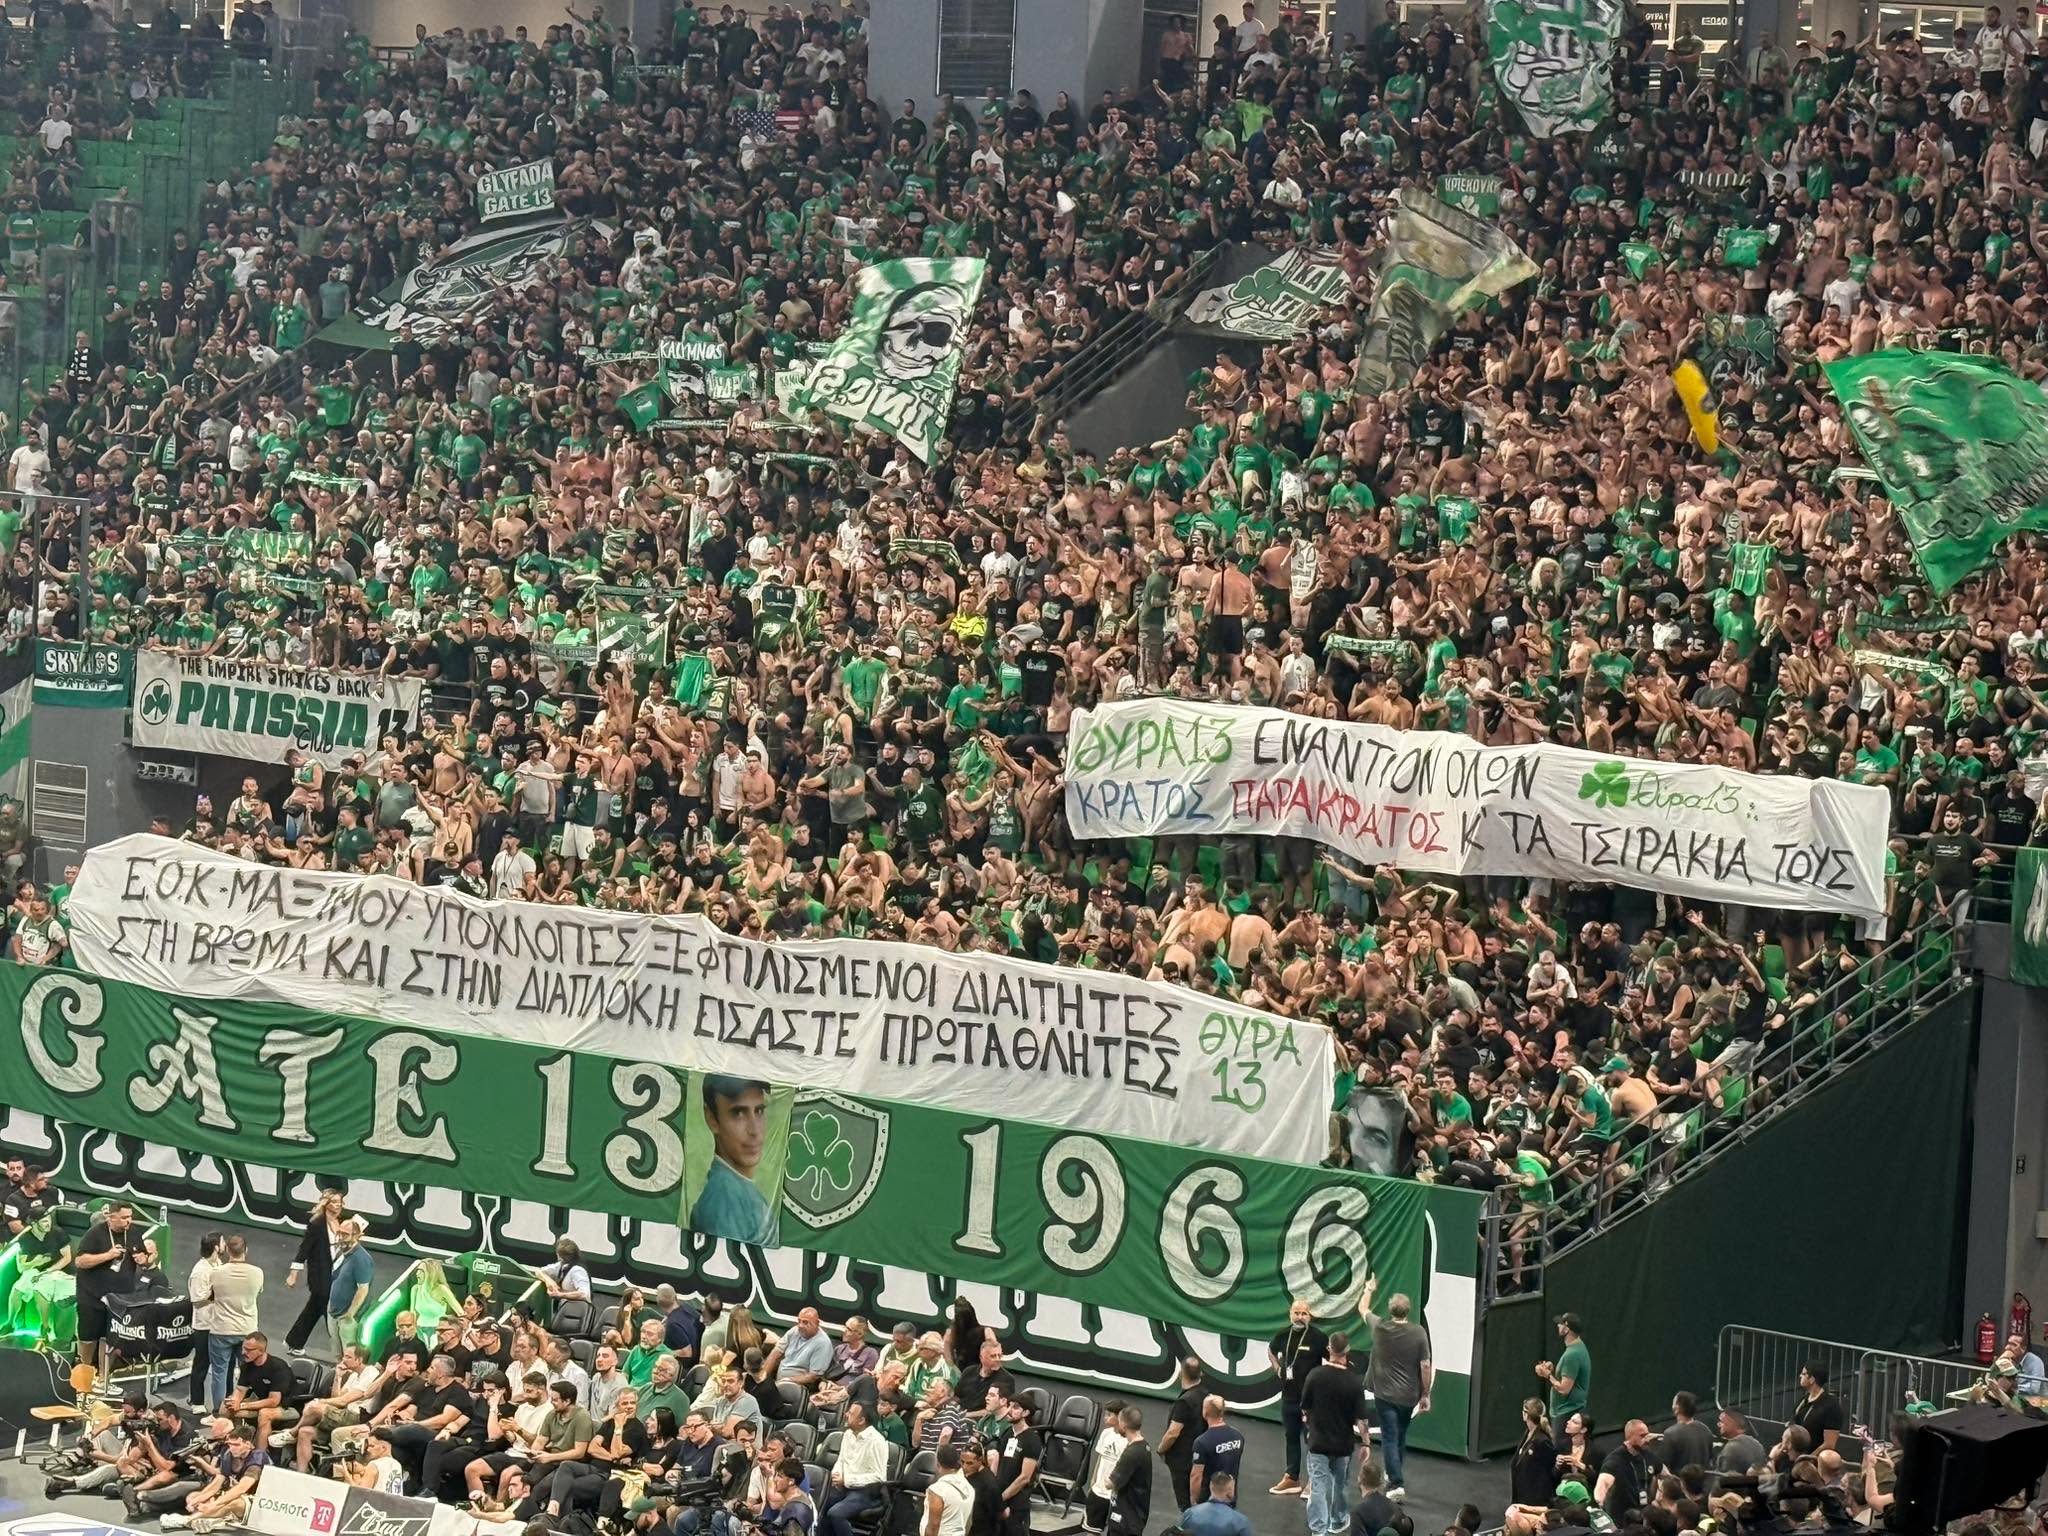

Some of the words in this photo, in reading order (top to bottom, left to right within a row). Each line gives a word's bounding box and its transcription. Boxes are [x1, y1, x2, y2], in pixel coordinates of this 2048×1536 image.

[477, 161, 555, 194] GLYFADA
[484, 193, 531, 215] GATE
[532, 187, 553, 206] 13
[179, 657, 202, 676] THE
[207, 660, 262, 684] EMPIRE
[267, 667, 331, 694] STRIKES
[337, 678, 370, 699] BACK
[175, 680, 369, 748] PATISSIA
[296, 727, 334, 754] Club
[1252, 717, 1441, 797] ΕΝΑΝΤΙΟΝ
[1445, 749, 1541, 801] ΟΛΩΝ
[1074, 778, 1215, 825] ΚΡΑΤΟΣ
[1229, 775, 1449, 853] ΠΑΡΑΚΡΑΤΟΣ
[1499, 811, 1556, 860] ΤΑ
[1570, 821, 1753, 887] ΤΣΙΡΑΚΙΑ
[1772, 841, 1856, 892] ΤΟΥΣ
[108, 915, 179, 964] ΣΤΗ
[187, 922, 309, 972] ΒΡΩΜΑ
[322, 936, 390, 988] ΚΑΙ
[401, 948, 502, 1007] ΣΤΗΝ
[515, 965, 680, 1031] ΔΙΑΠΛΟΚΗ
[693, 992, 860, 1057] ΕΙΣΑΣΤΕ
[879, 1012, 1181, 1100] ΠΡΩΤΑΘΛΗΤΕΣ
[646, 923, 937, 1008] ΞΕΦΤΙΛΙΣΜΕΝΟΙ
[952, 971, 1184, 1047] ΔΙΑΙΤΗΤΕΣ
[1199, 1011, 1302, 1066] ΘΥΡΑ
[1210, 1057, 1267, 1114] 13
[20, 971, 458, 1164] GATE
[532, 1052, 685, 1194] 13
[952, 1122, 1375, 1320] 1966
